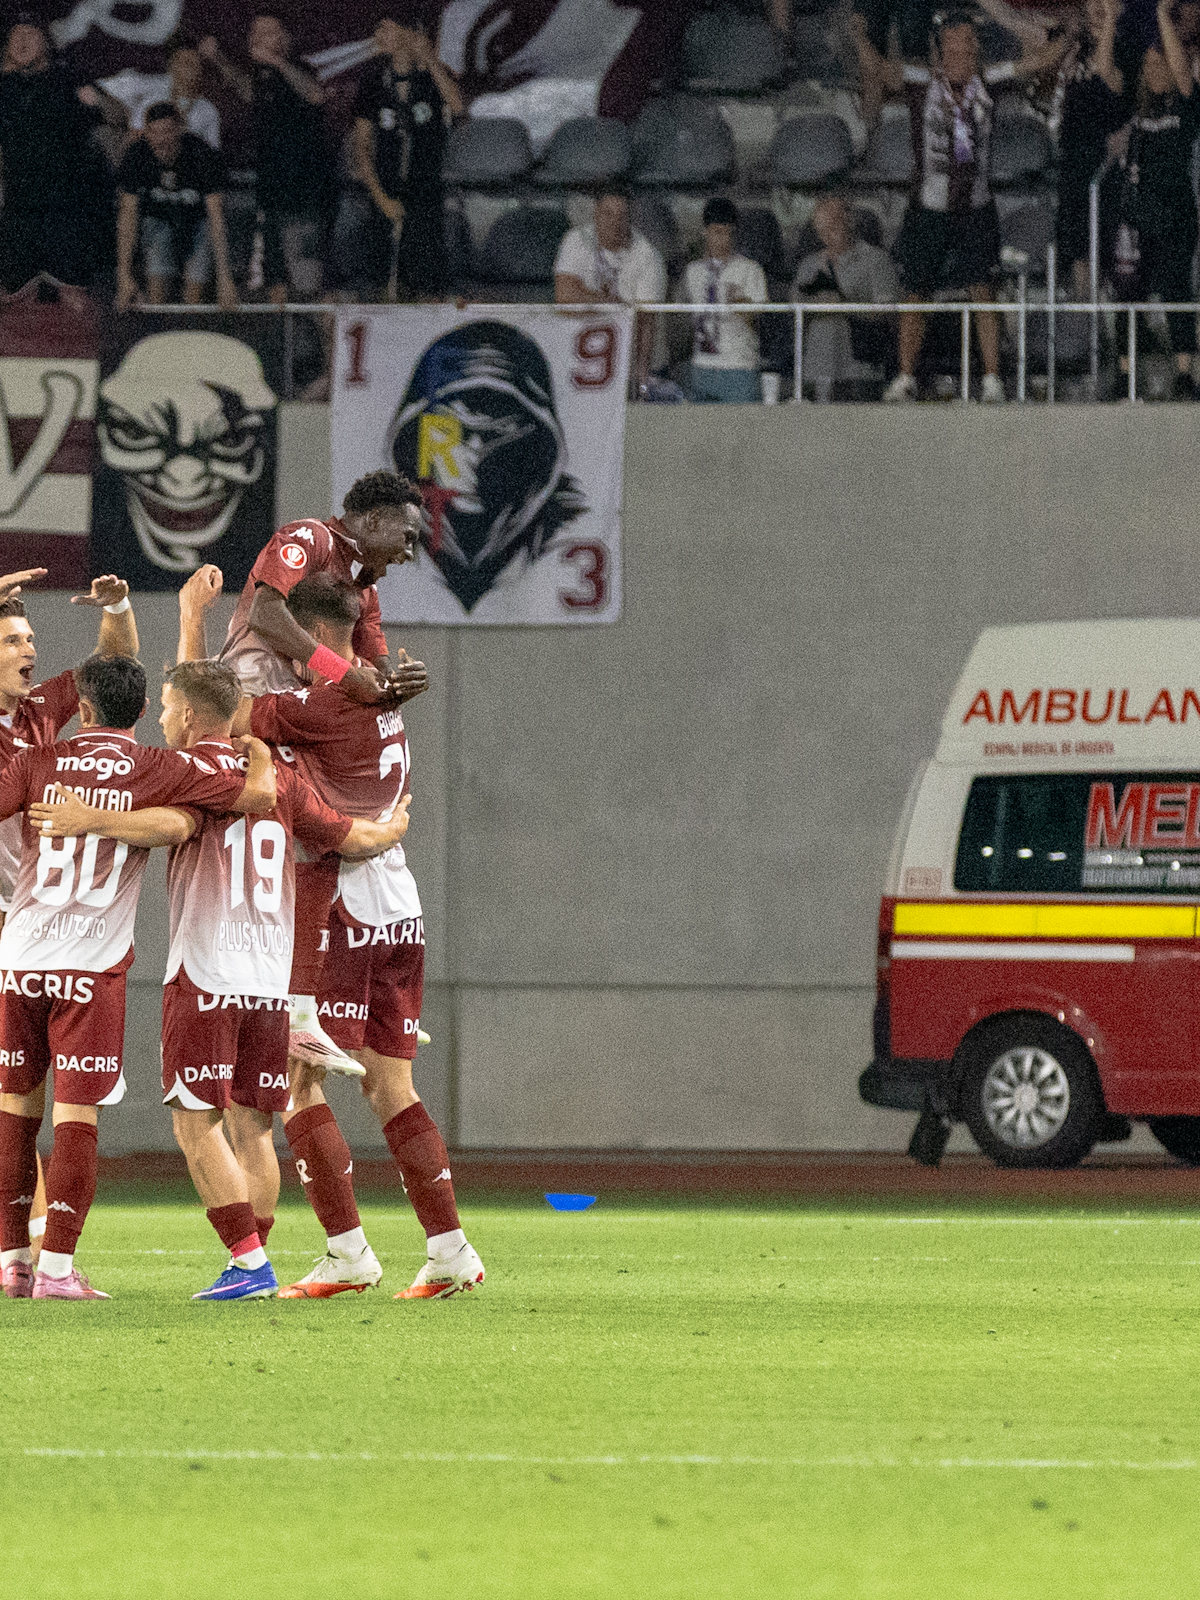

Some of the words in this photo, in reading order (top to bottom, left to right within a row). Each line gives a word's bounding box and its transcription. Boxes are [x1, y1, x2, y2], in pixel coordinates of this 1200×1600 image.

[345, 321, 370, 388] 1
[571, 323, 618, 391] 9
[417, 414, 463, 477] R
[558, 542, 610, 613] 3
[56, 756, 132, 781] mogo
[379, 738, 411, 823] 2
[224, 816, 286, 913] 19
[316, 1001, 368, 1021] ACRIS
[56, 1054, 118, 1072] DACRIS
[184, 1064, 234, 1083] DACRIS
